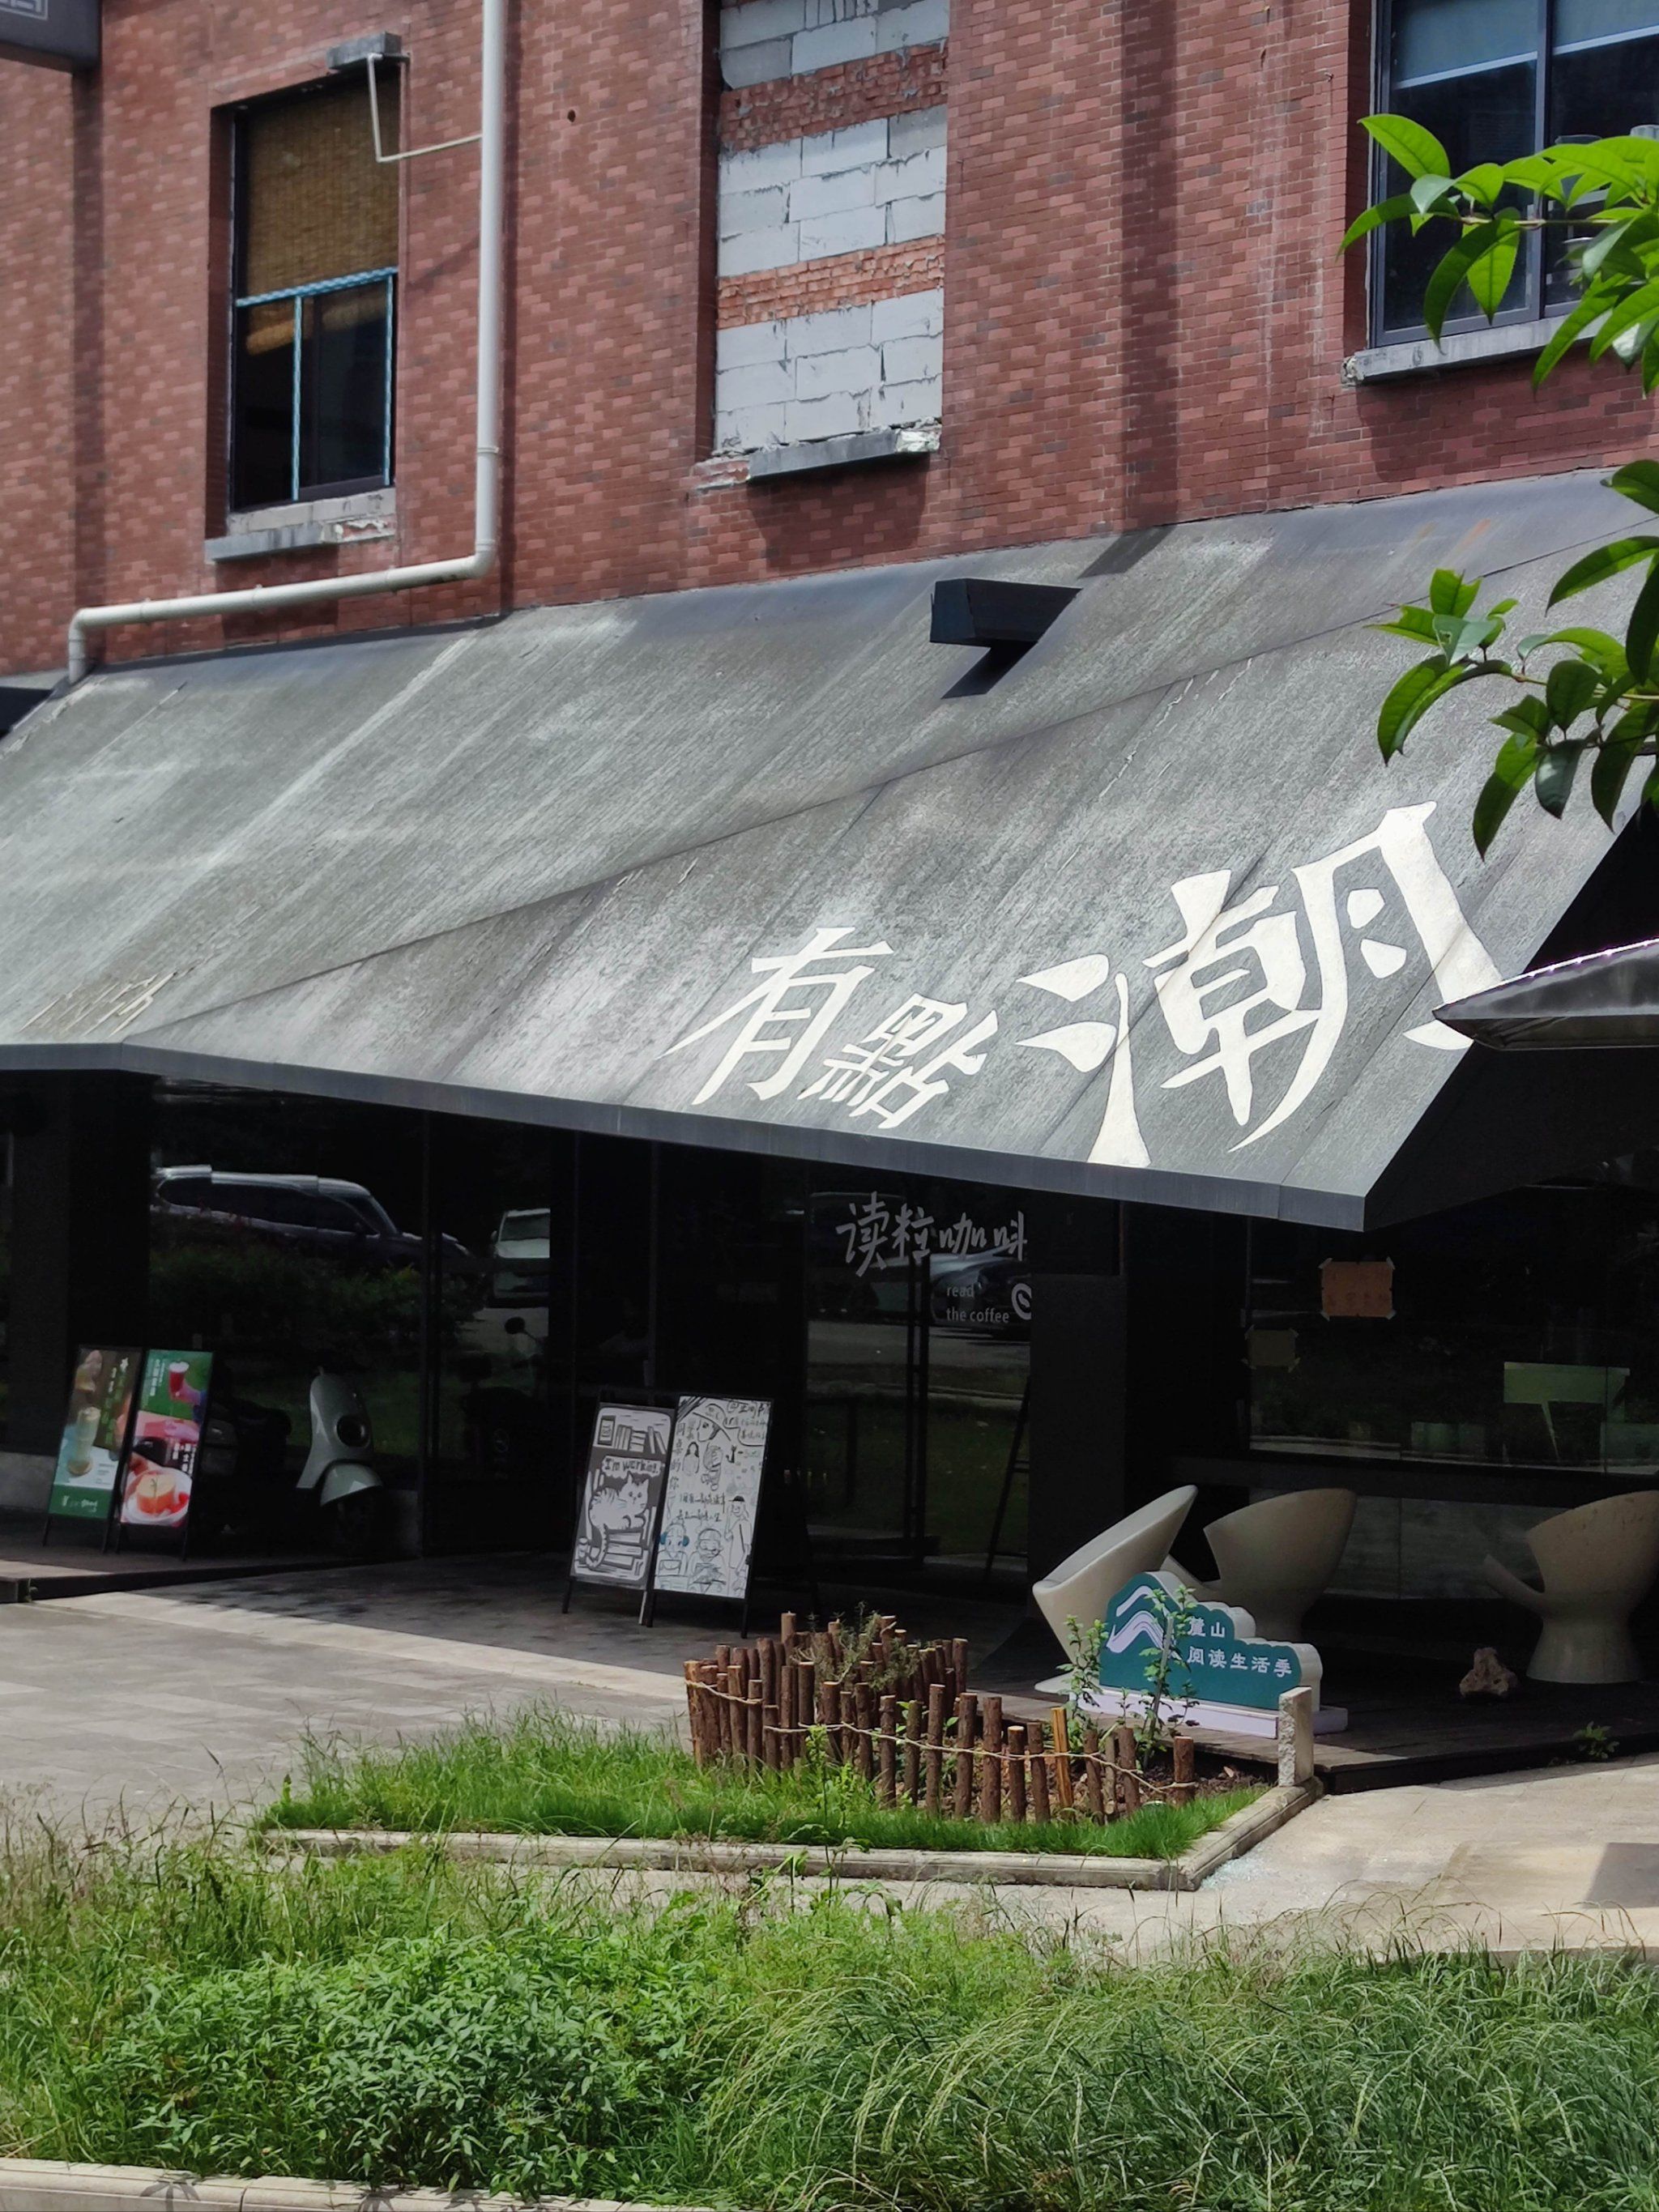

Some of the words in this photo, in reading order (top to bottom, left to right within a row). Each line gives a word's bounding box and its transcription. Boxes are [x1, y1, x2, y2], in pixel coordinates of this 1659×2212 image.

[659, 800, 1504, 1168] 有點潮
[946, 1284, 975, 1298] read
[946, 1306, 966, 1322] the
[970, 1306, 1010, 1323] coffee
[1187, 1645, 1293, 1678] 阅读生活季
